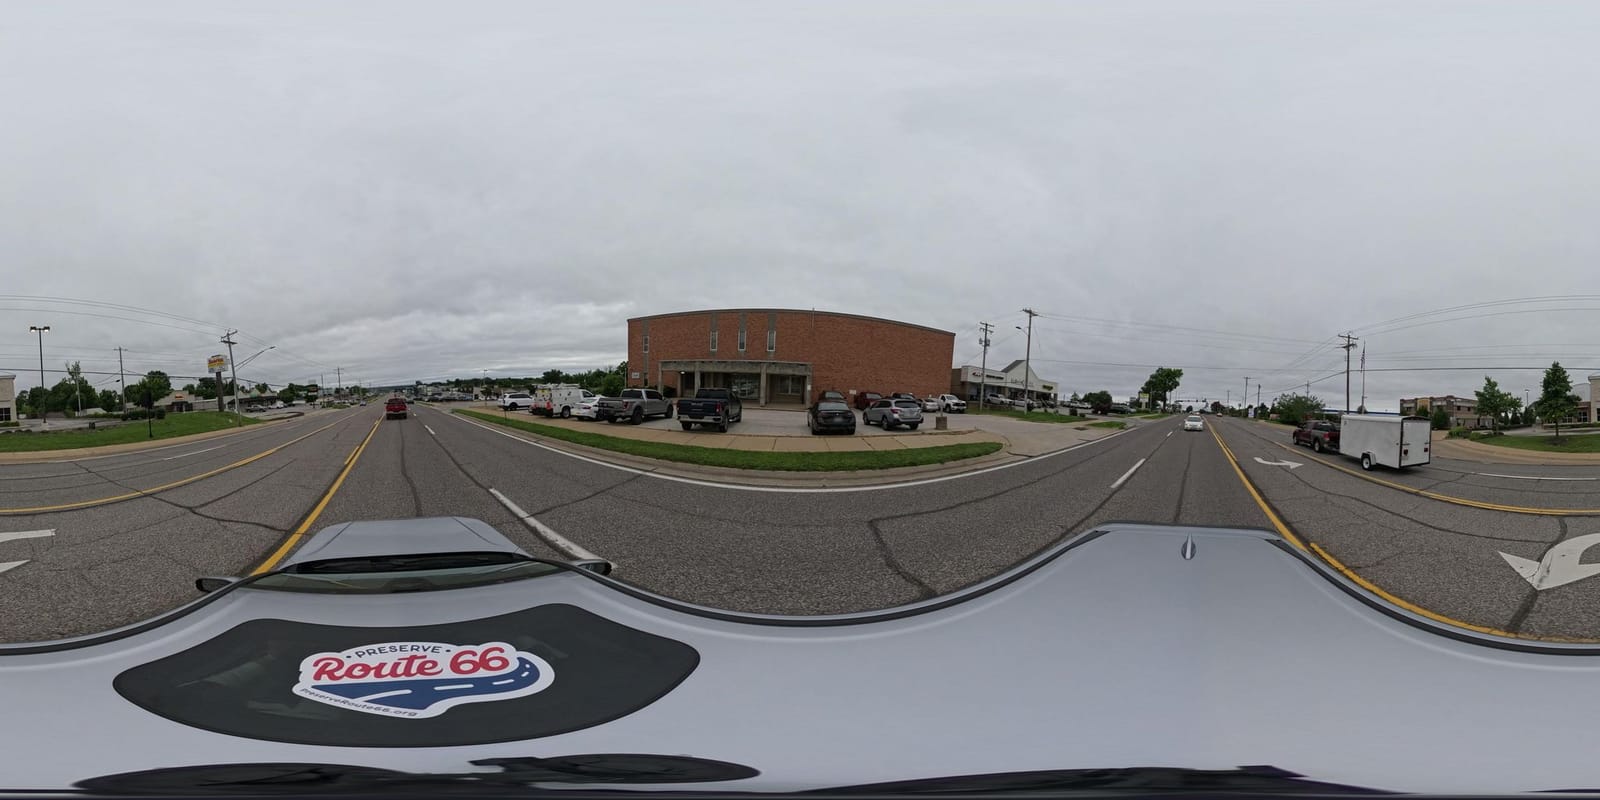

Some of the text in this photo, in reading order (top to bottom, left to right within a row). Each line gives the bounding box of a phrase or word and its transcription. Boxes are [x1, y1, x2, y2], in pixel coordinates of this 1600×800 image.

[312, 646, 510, 681] Route 66
[355, 644, 443, 659] PRESERVE
[300, 688, 418, 717] PreserveRoute66.org
